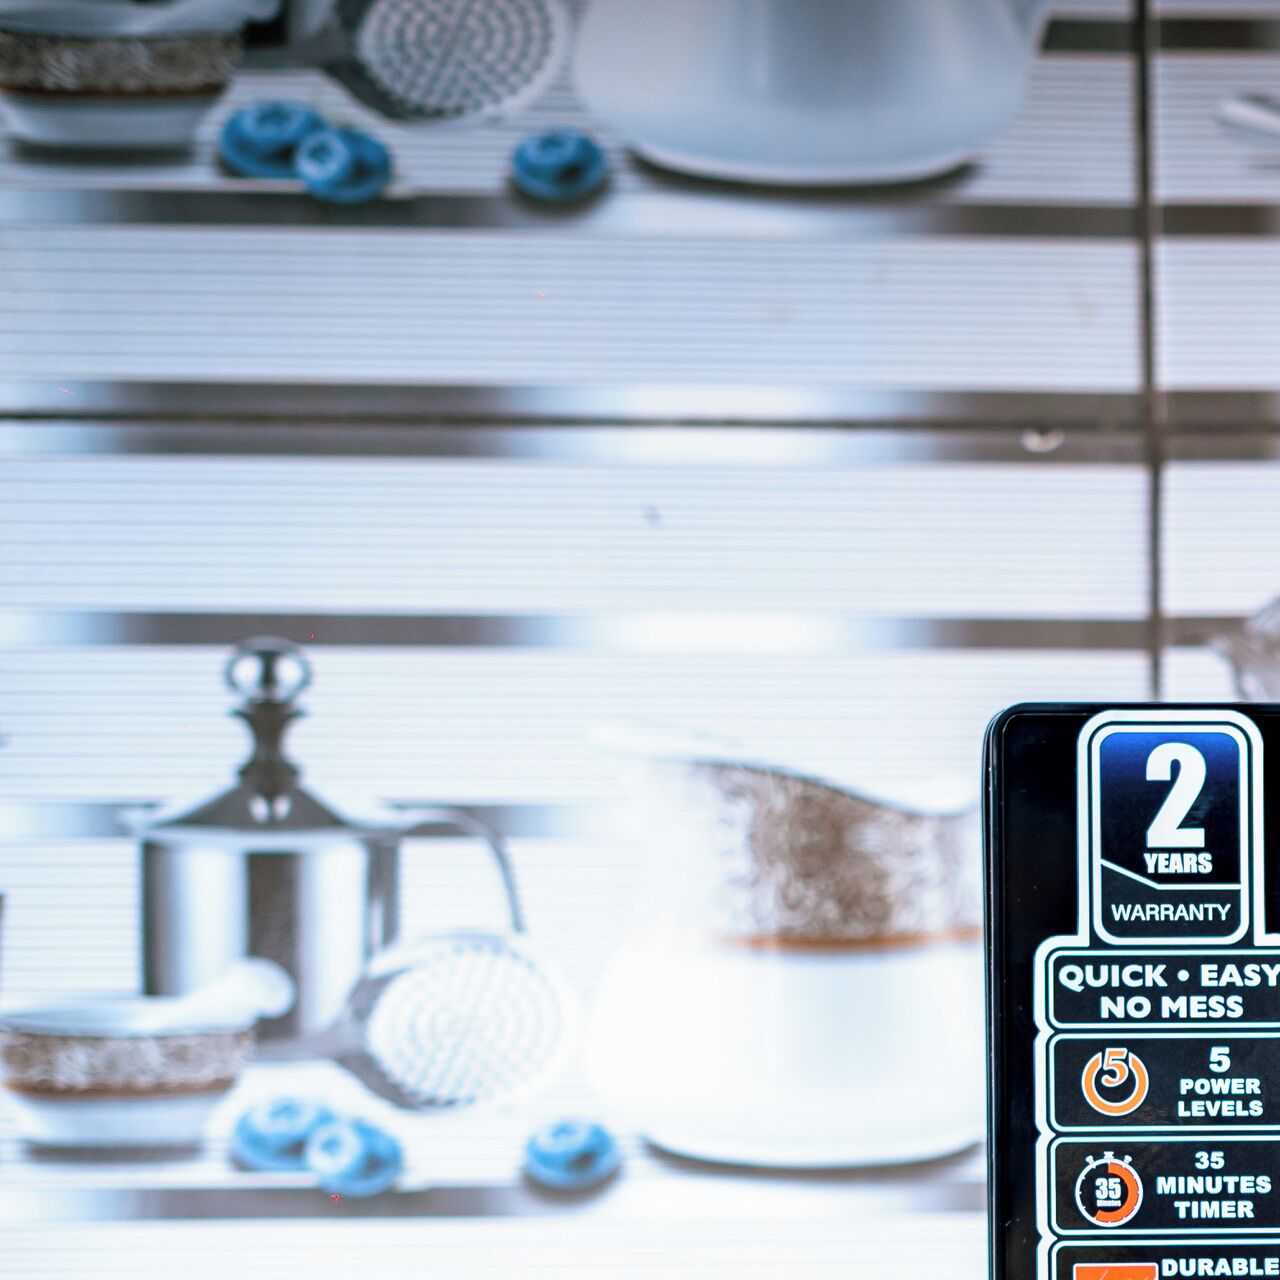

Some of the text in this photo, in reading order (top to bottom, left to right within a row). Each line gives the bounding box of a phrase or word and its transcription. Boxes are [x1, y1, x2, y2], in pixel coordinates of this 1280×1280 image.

[1145, 742, 1207, 849] 2
[1144, 853, 1213, 874] YEARS
[1111, 903, 1232, 922] WARRANTY
[1058, 964, 1168, 993] QUICK
[1100, 995, 1244, 1019] NO MESS
[1101, 1047, 1129, 1088] 5
[1209, 1046, 1231, 1073] 5
[1180, 1078, 1262, 1095] POWER
[1177, 1099, 1264, 1118] LEVELS
[1194, 1151, 1225, 1170] 35
[1095, 1177, 1122, 1200] 35
[1156, 1175, 1272, 1194] MINUTES
[1173, 1200, 1255, 1219] TIMER
[1161, 1257, 1280, 1277] DURABLE
